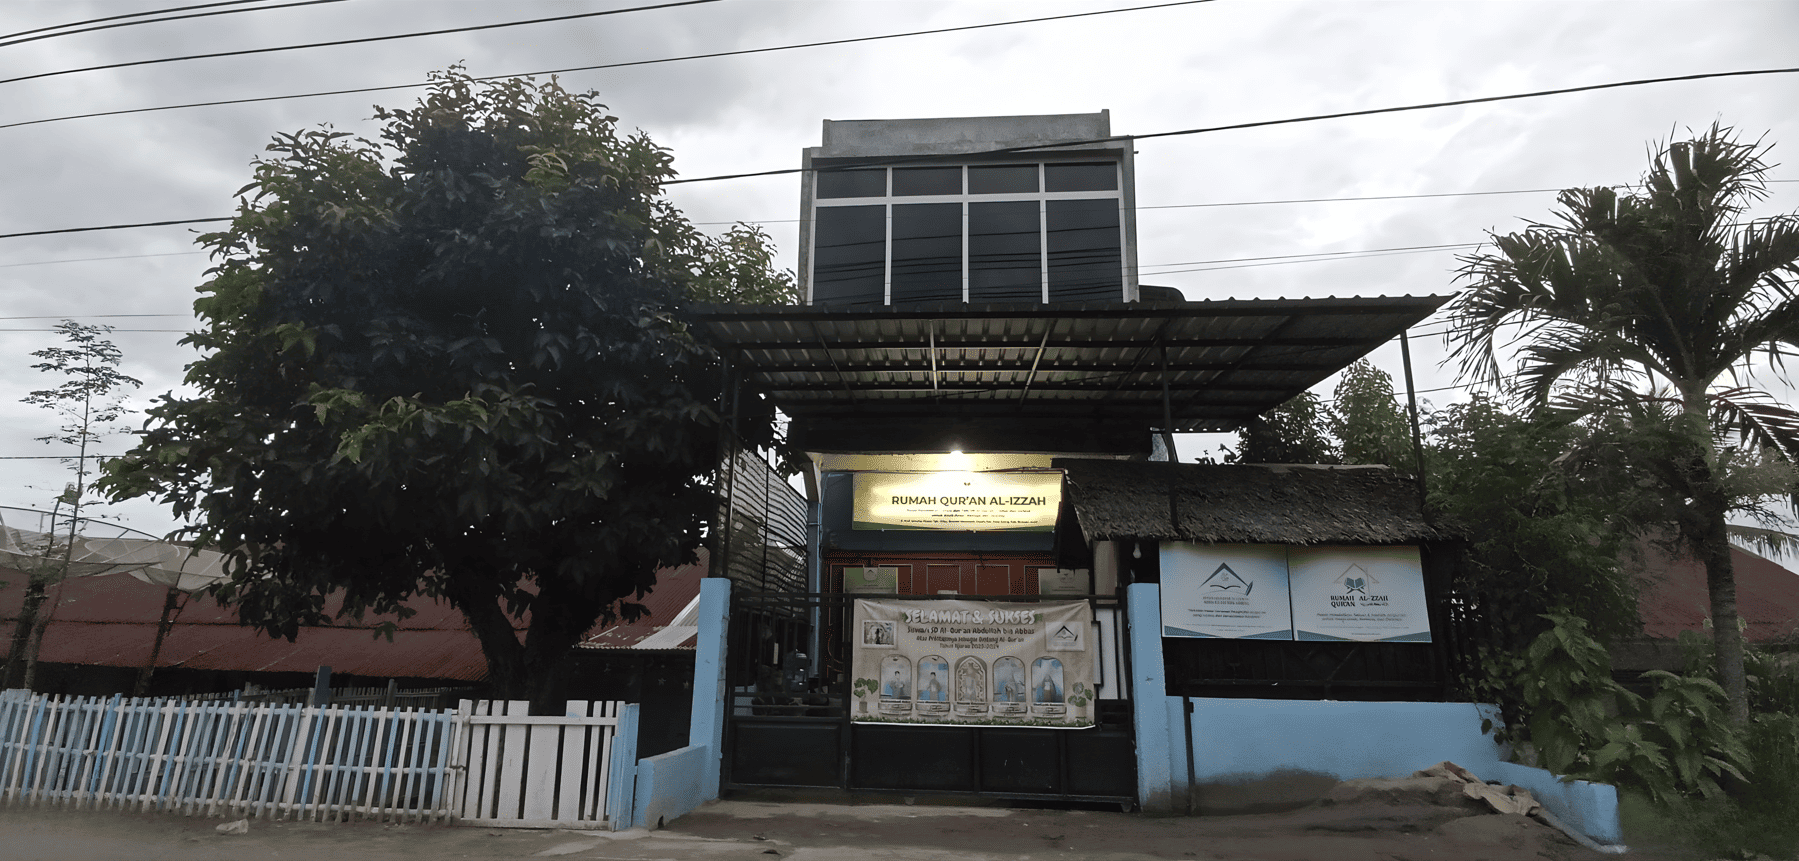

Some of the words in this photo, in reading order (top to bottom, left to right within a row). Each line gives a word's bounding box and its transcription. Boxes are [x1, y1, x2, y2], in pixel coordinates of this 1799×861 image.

[891, 496, 936, 505] RUMAH
[940, 496, 986, 507] QUR'AN
[989, 496, 1046, 506] AL-IZZAH
[905, 609, 969, 624] SELAMAT
[972, 610, 983, 624] &
[988, 609, 1035, 625] SUKSES
